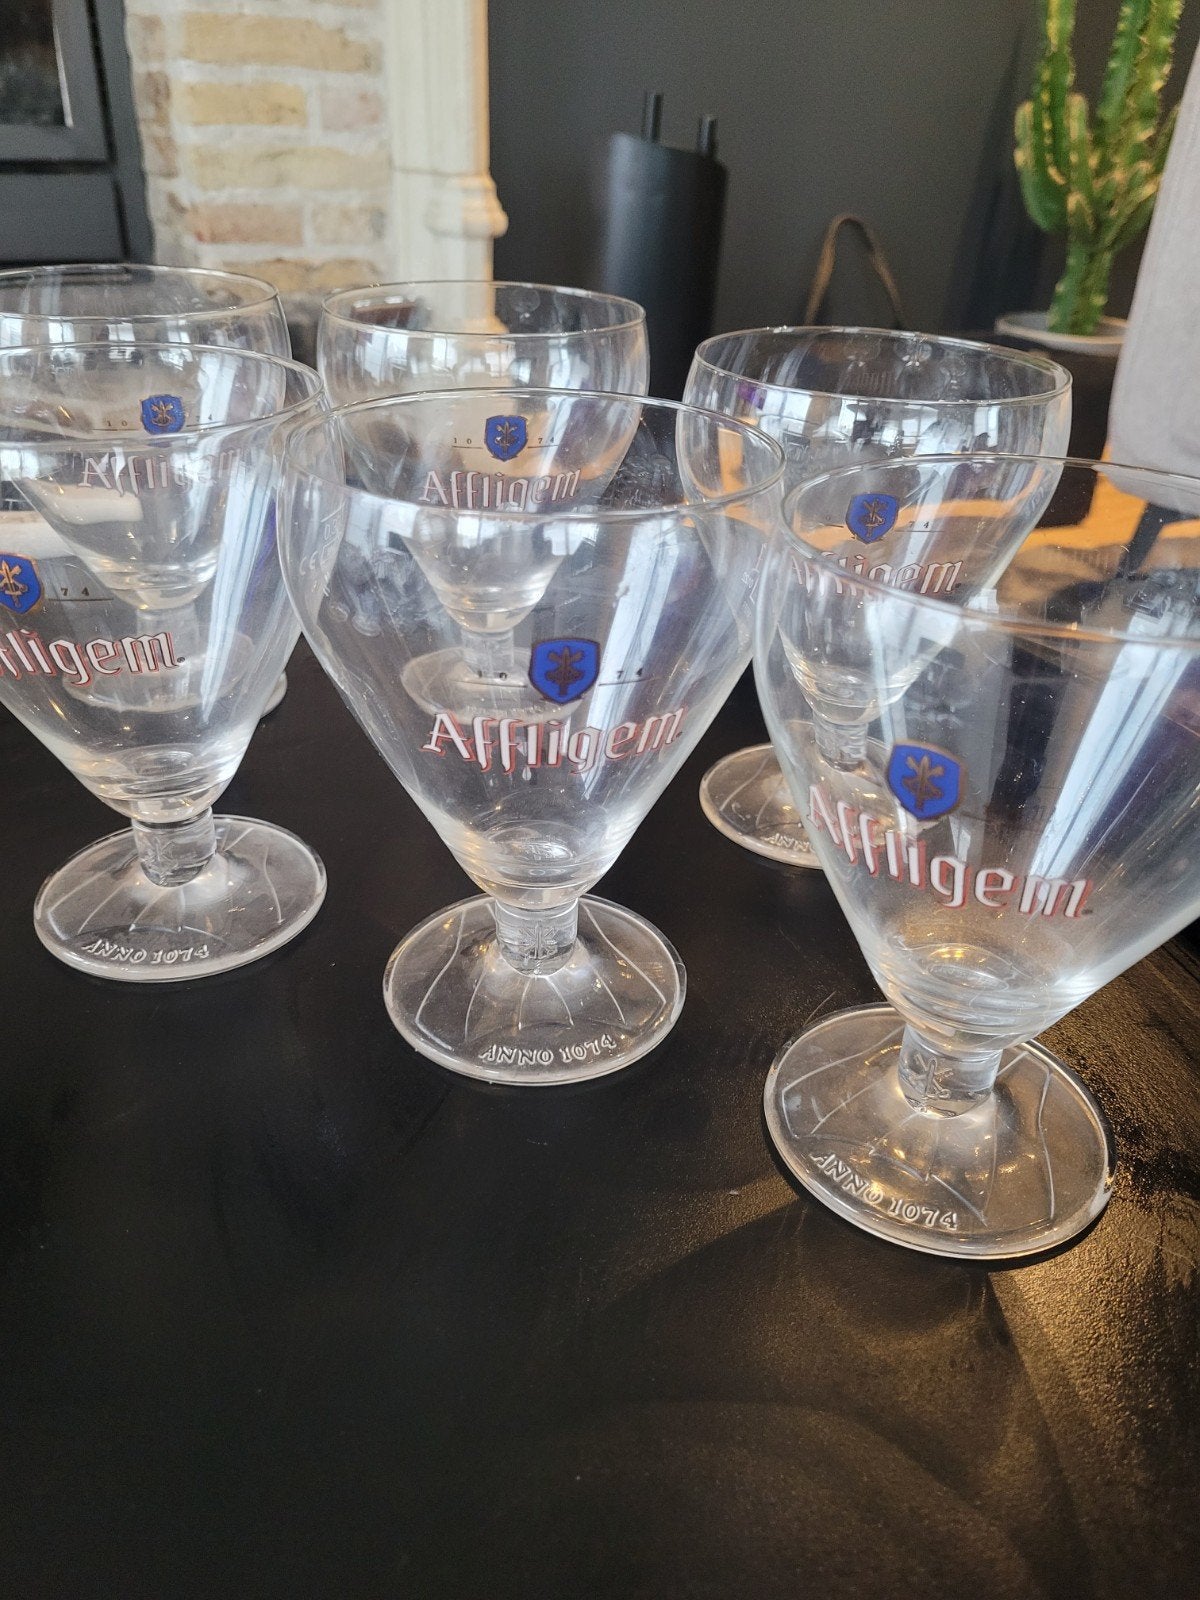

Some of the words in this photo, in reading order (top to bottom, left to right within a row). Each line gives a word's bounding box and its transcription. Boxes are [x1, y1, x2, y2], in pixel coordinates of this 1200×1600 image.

[418, 469, 581, 512] Affligem
[419, 706, 688, 775] Affligem
[806, 784, 1094, 918] Affligem
[81, 939, 147, 963] ANNO
[151, 944, 210, 964] 1074
[478, 1044, 554, 1065] ANNO
[559, 1034, 617, 1063] 1074
[809, 1153, 884, 1205] ANNO
[888, 1198, 958, 1231] 1074
